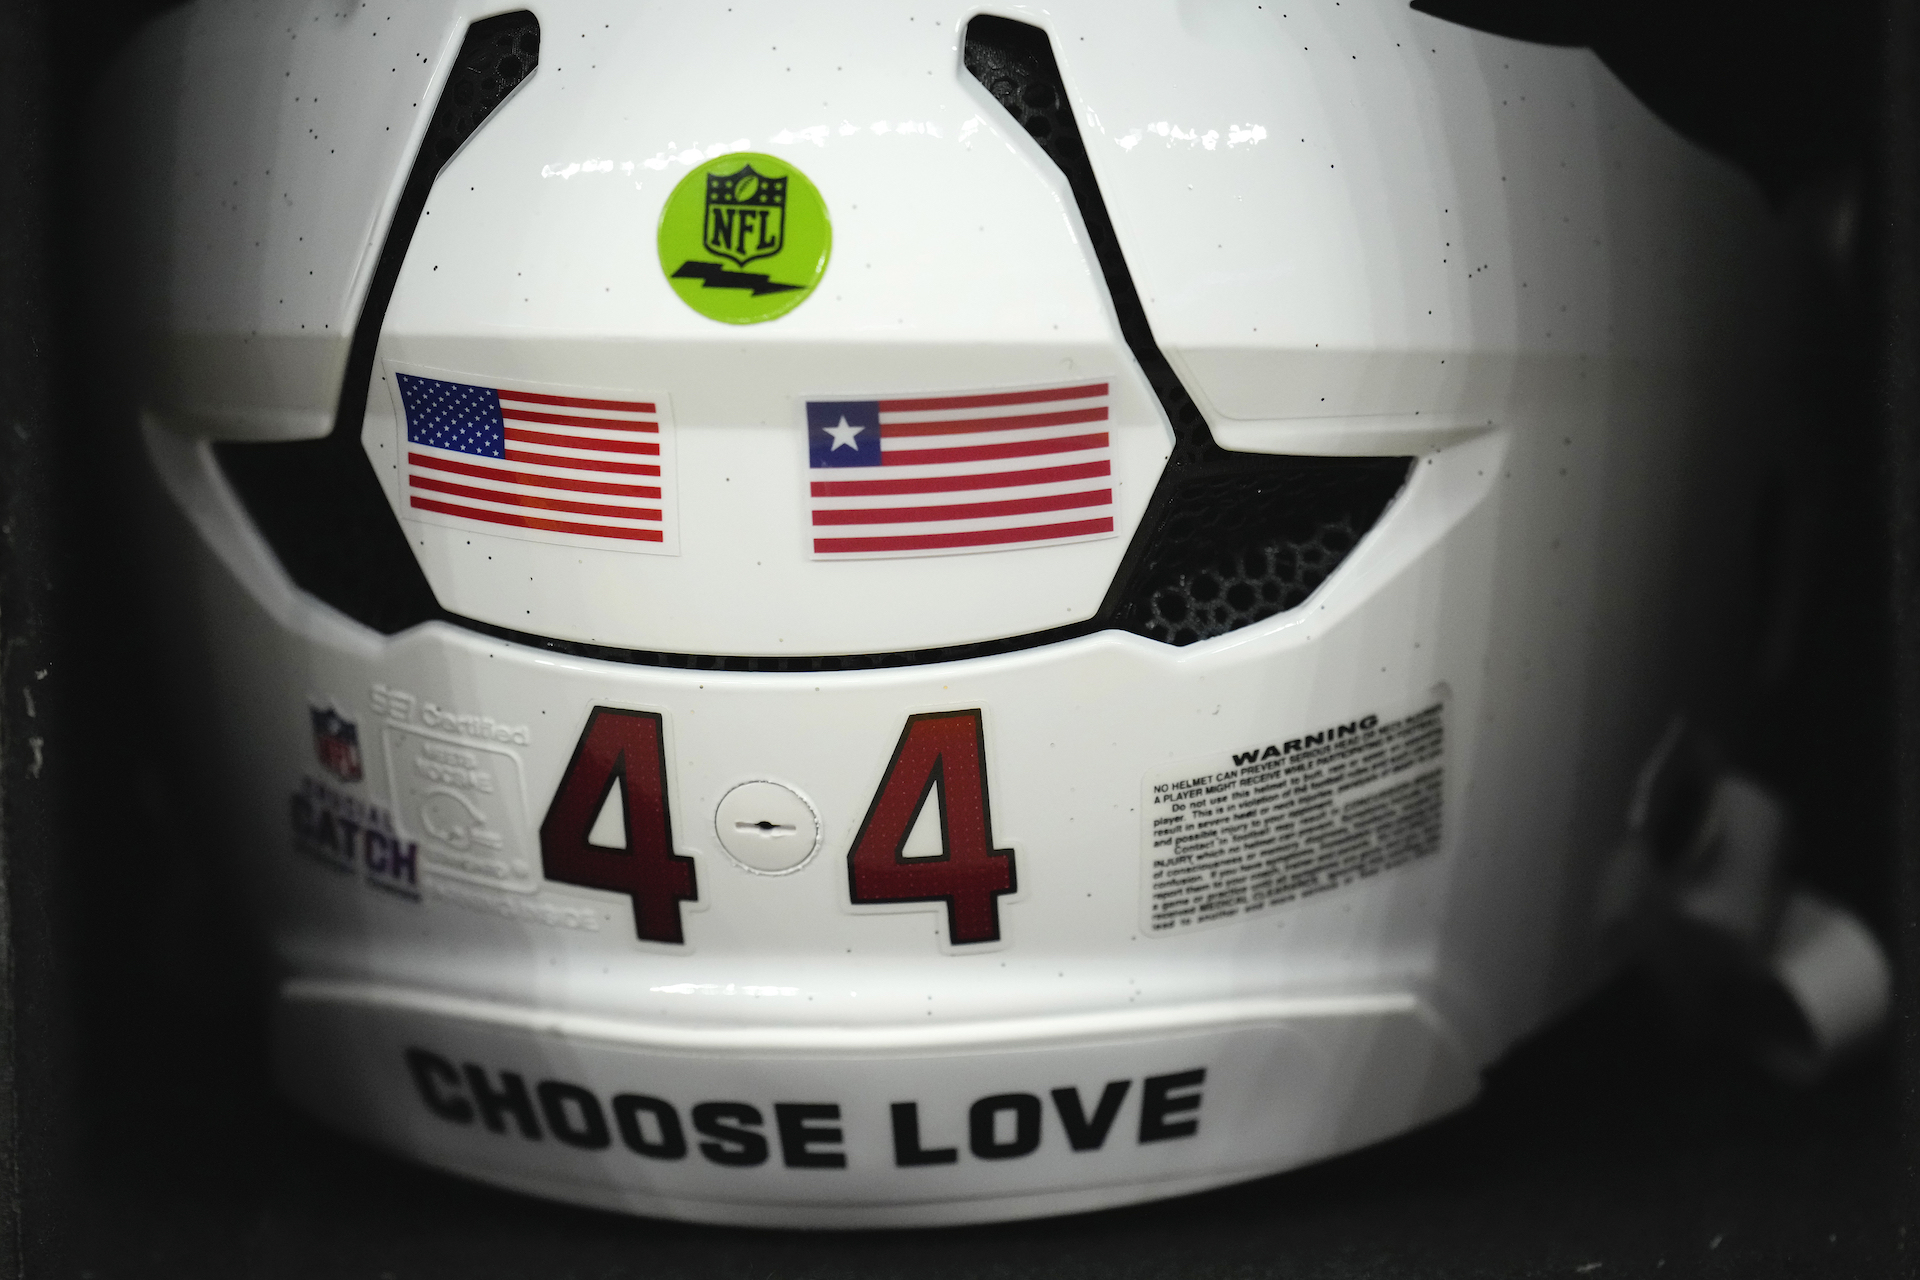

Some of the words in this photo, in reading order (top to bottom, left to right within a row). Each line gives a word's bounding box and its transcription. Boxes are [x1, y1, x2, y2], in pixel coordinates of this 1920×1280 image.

[711, 208, 775, 255] NFL
[423, 703, 530, 748] Certified
[1232, 715, 1378, 766] WARNING
[1153, 784, 1169, 794] NO
[1171, 775, 1213, 791] HELMET
[1215, 770, 1238, 782] CAN
[1240, 757, 1286, 776] PREVENT
[1154, 796, 1161, 805] A
[1163, 788, 1203, 803] PLAYER
[1205, 781, 1237, 795] MIGHT
[1239, 770, 1281, 788] RECEIVE
[1172, 803, 1186, 813] Do
[1189, 799, 1206, 809] not
[1209, 795, 1227, 805] use
[1231, 790, 1250, 801] this
[1254, 780, 1287, 794] helmet
[1192, 809, 1213, 819] This
[1238, 794, 1279, 808] violation
[539, 705, 699, 945] 4
[847, 708, 1018, 945] 4
[1153, 825, 1182, 837] result
[1184, 823, 1195, 831] in
[1197, 816, 1230, 829] severe
[1153, 837, 1172, 848] and
[1175, 829, 1218, 847] possible
[1220, 824, 1248, 837] injury
[1174, 840, 1215, 855] Contact
[403, 1046, 848, 1170] CHOOSE
[890, 1068, 1207, 1168] LOVE
